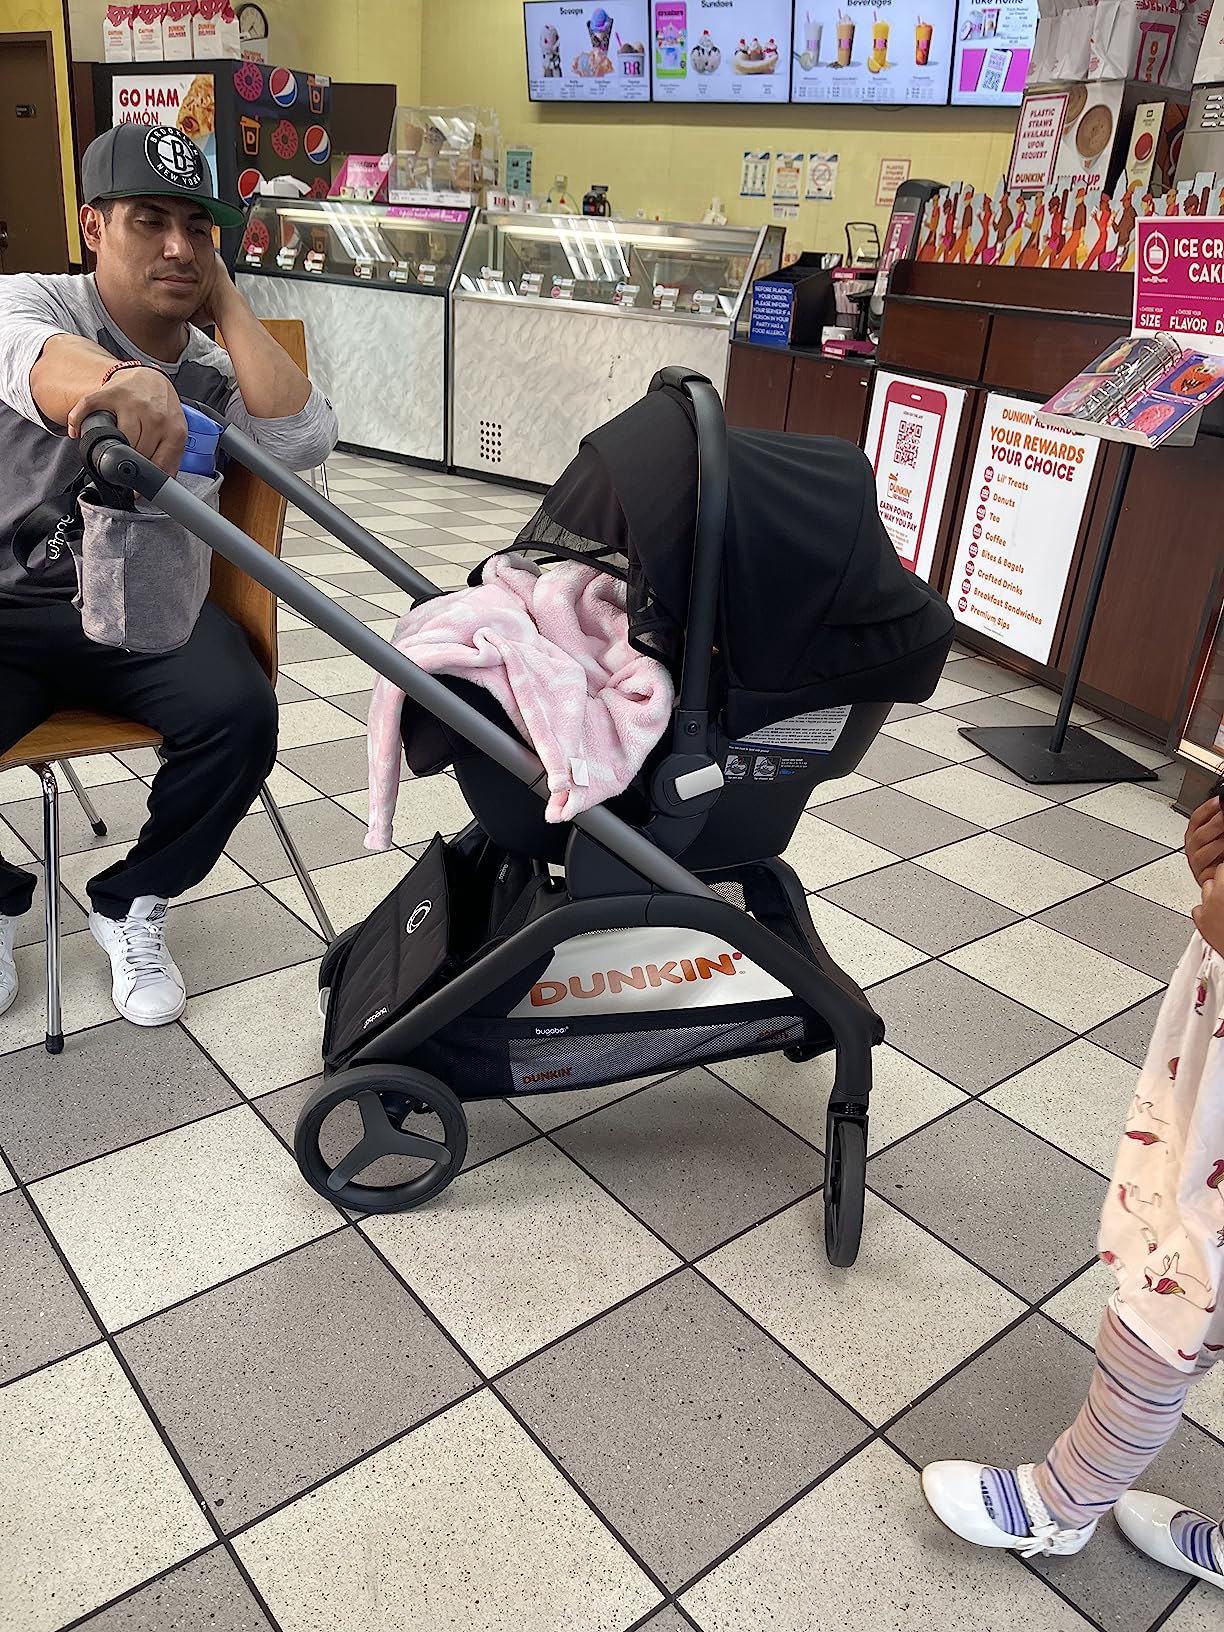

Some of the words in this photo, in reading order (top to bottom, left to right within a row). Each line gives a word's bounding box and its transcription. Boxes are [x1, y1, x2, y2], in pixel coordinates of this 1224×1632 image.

[560, 7, 583, 16] Scoops
[119, 88, 140, 107] GO
[145, 88, 179, 107] HAM
[1030, 108, 1056, 117] PLASTIC
[1028, 120, 1052, 128] STRAWS
[1022, 130, 1054, 138] AVAILABLE
[1027, 140, 1044, 149] UPON
[1021, 150, 1048, 159] REQUEST
[156, 162, 178, 182] NEW
[1015, 172, 1046, 183] DUNKIN'
[1174, 238, 1198, 258] ICE
[1201, 238, 1224, 259] CR
[1188, 262, 1224, 284] CAK
[1140, 313, 1161, 328] SIZE
[1169, 316, 1208, 333] FLAVOR
[1215, 319, 1224, 334] D
[1002, 408, 1035, 426] DUNKIN'
[990, 425, 1021, 448] YOUR
[1023, 436, 1085, 464] REWARDS
[991, 444, 1022, 467] YOUR
[1025, 455, 1076, 482] CHOICE
[1008, 477, 1029, 491] Treats
[993, 493, 1015, 507] Donuts
[880, 500, 893, 513] EARN
[893, 506, 913, 520] POINTS
[989, 511, 1000, 523] Tea
[884, 512, 895, 523] WAY
[896, 516, 907, 528] YOU
[907, 521, 917, 532] PAY
[985, 532, 1007, 547] Coffee
[982, 549, 996, 563] Bites
[997, 556, 1002, 565] &
[1004, 558, 1024, 574] Bagels
[977, 569, 1002, 586] Crafted
[1003, 579, 1023, 596] Drinks
[974, 587, 1003, 608] Breakfast
[1004, 601, 1042, 625] Sandwiches
[970, 604, 997, 623] Premium
[997, 617, 1010, 630] Sips
[531, 952, 743, 1007] DUNKIN'
